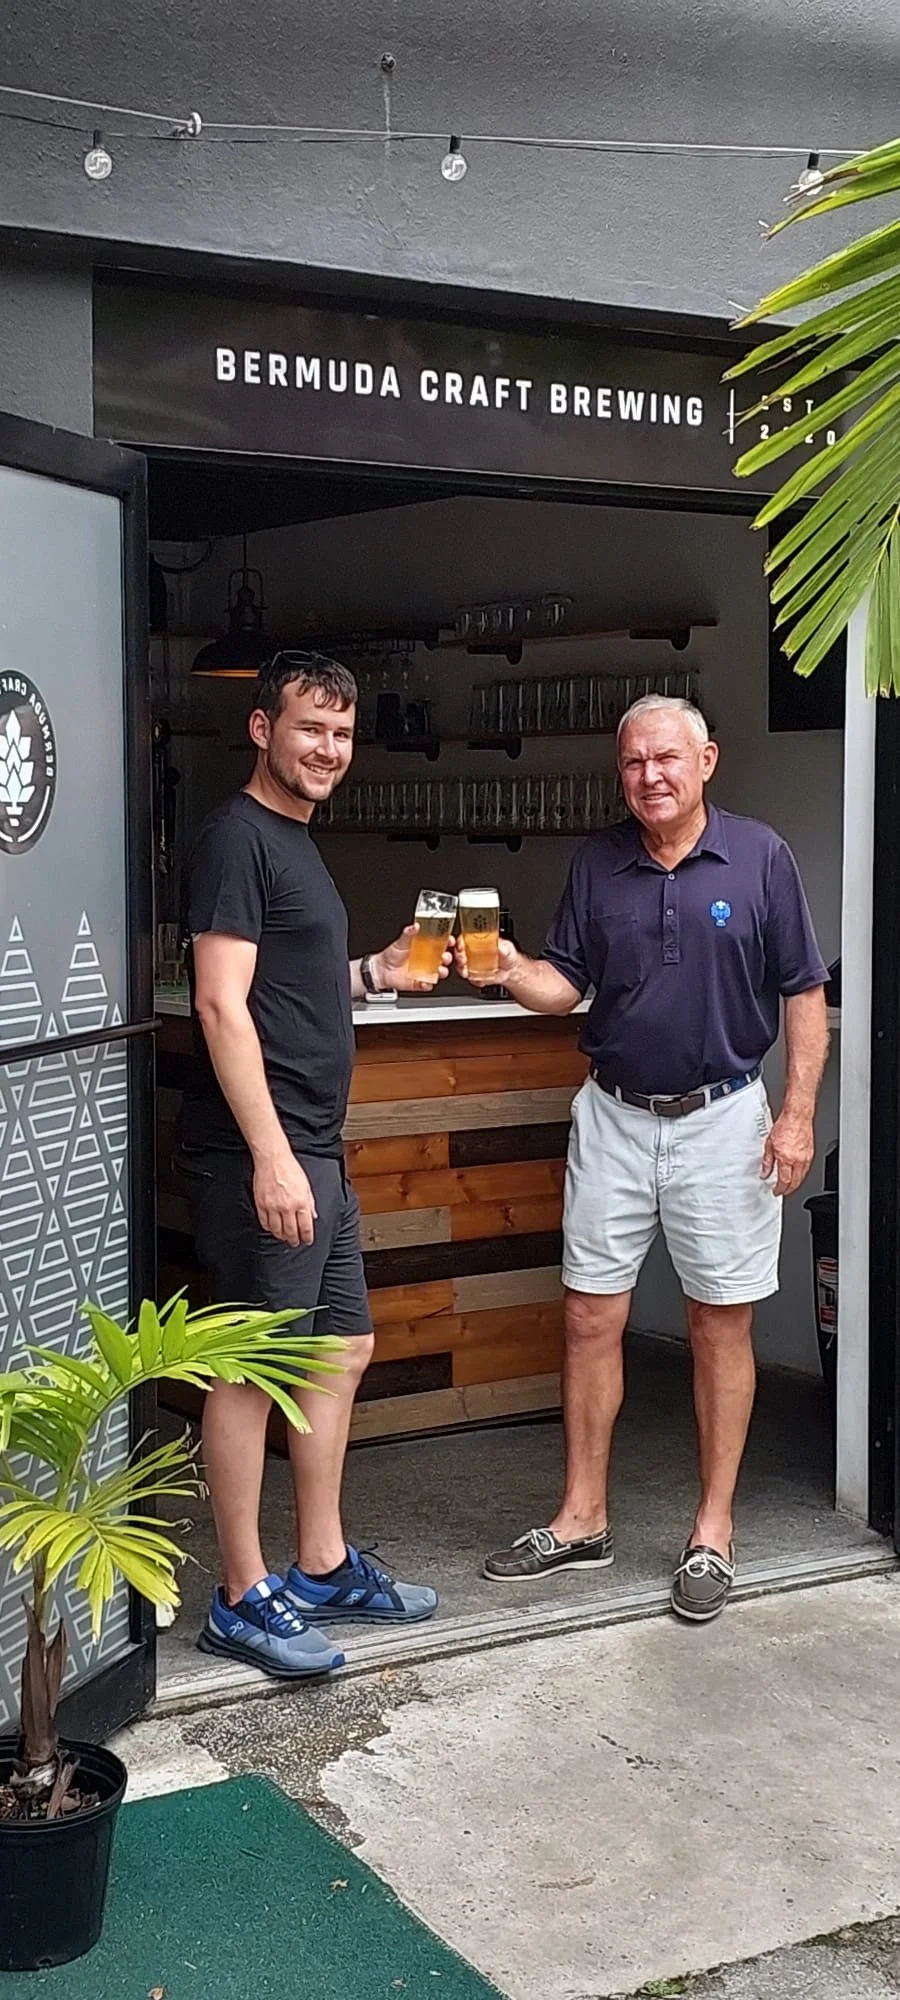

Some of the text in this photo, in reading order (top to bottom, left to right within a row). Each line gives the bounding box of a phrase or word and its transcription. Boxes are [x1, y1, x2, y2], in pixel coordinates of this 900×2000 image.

[216, 347, 703, 426] BERMUDA CRAFT BREWING
[759, 424, 836, 446] 220
